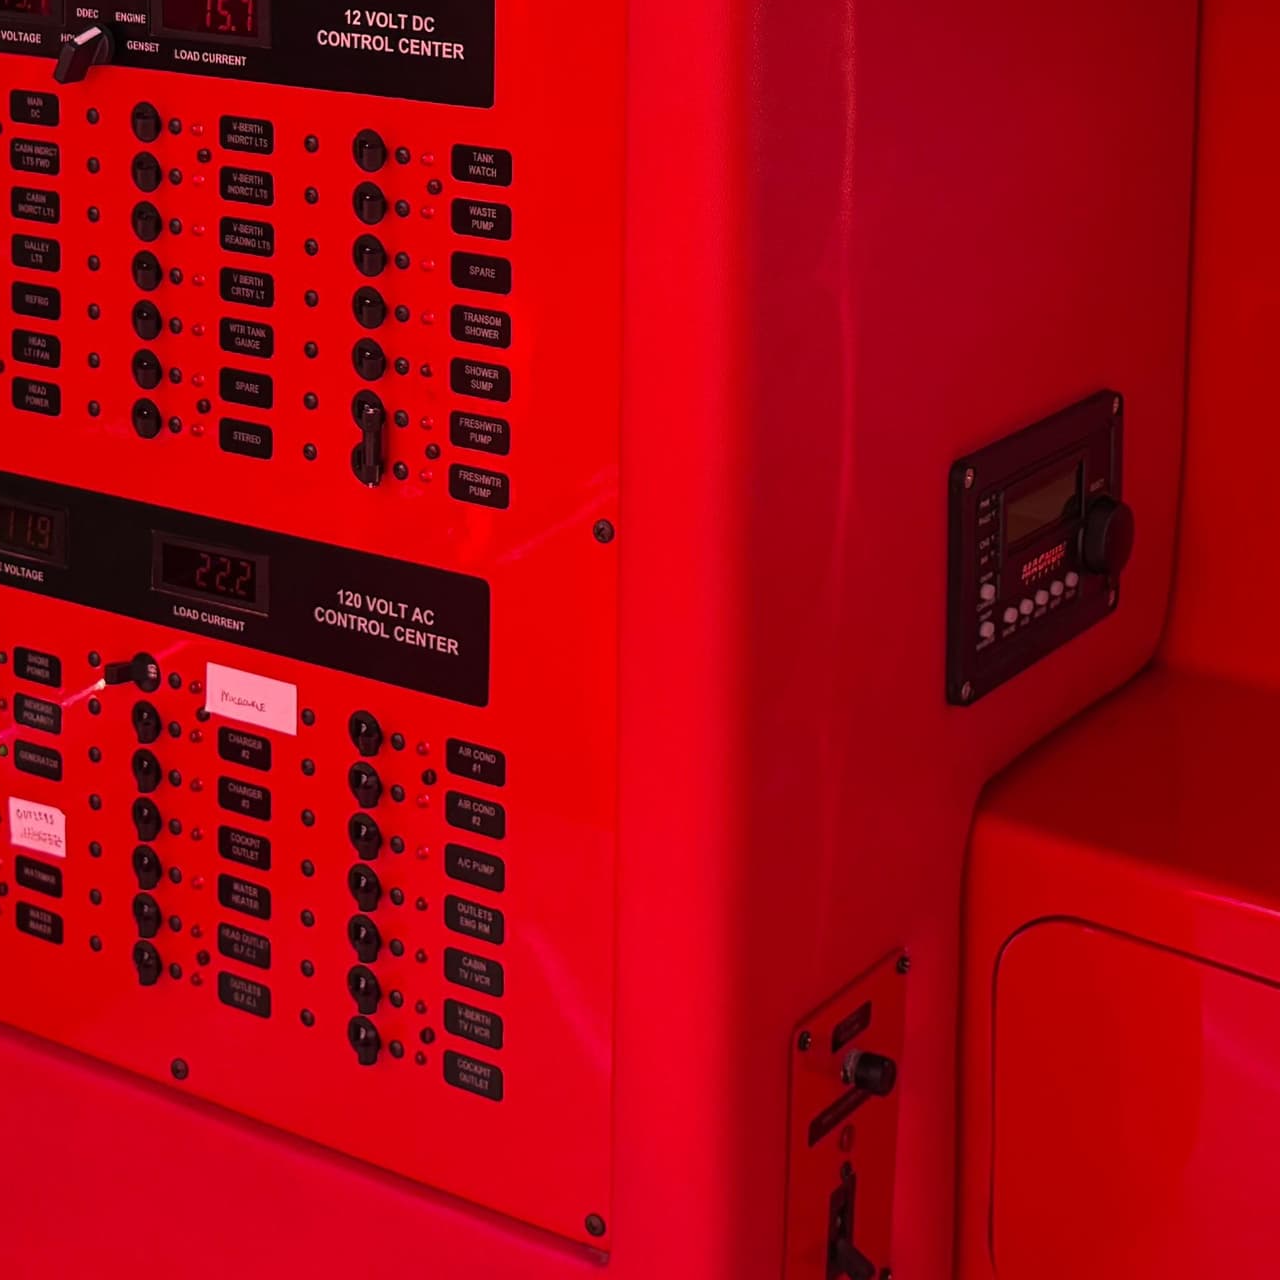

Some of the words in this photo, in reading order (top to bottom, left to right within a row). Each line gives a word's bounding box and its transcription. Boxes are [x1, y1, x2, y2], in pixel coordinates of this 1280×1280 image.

[76, 8, 99, 19] DDEC
[115, 11, 146, 24] ENGINE
[344, 9, 361, 26] 12
[365, 10, 408, 30] VOLT
[412, 15, 435, 33] DC
[1, 30, 41, 44] VOLTAGE
[317, 29, 394, 53] CONTROL
[398, 37, 465, 60] CENTER
[127, 40, 160, 53] GENSET
[174, 49, 200, 62] LOAD
[202, 52, 247, 66] CURRENT
[227, 134, 253, 145] INDRCT
[254, 137, 268, 148] LTS
[472, 152, 494, 164] TANK
[469, 165, 497, 178] WATCH
[227, 185, 253, 196] INDRCT
[255, 188, 268, 199] LTS
[469, 206, 496, 218] WASTE
[472, 219, 494, 231] PUMP
[24, 240, 49, 253] GALLEY
[225, 234, 256, 247] READING
[257, 240, 270, 250] LTS
[469, 265, 496, 278] SPARE
[255, 290, 264, 300] LT
[464, 312, 501, 327] TRANSOM
[247, 326, 266, 338] TANK
[464, 325, 499, 340] SHOWER
[235, 337, 260, 350] GAUGE
[465, 365, 499, 380] SHOWER
[235, 381, 259, 393] SPARE
[470, 379, 493, 391] SUMP
[459, 417, 502, 433] FRESHWTR
[233, 431, 261, 444] STEREO
[470, 432, 492, 444] PUMP
[459, 470, 501, 488] FRESHWTR
[469, 485, 491, 497] PUMP
[4, 563, 44, 581] VOLTAGE
[196, 553, 251, 595] 22.2
[337, 589, 361, 608] 120
[366, 595, 408, 619] VOLT
[412, 607, 434, 626] AC
[173, 605, 199, 620] LOAD
[201, 612, 245, 631] CURRENT
[314, 606, 390, 639] CONTROL
[394, 626, 459, 656] CENTER
[228, 733, 262, 750] CHARGER
[458, 746, 472, 758] AIR
[473, 750, 496, 764] COND
[472, 763, 481, 774] #1
[228, 782, 262, 800] CHARGER
[458, 798, 471, 810] AIR
[472, 802, 495, 816] COND
[472, 815, 481, 826] #2
[231, 832, 260, 848] COCKPIT
[232, 845, 259, 861] OUTLET
[457, 857, 471, 868] A/C
[472, 861, 495, 874] PUMP
[233, 881, 258, 898] WATER
[457, 902, 493, 922] OUTLETS
[460, 916, 476, 930] ENG
[478, 921, 490, 934] RM
[462, 957, 487, 972] CABIN
[457, 1058, 491, 1078] COCKPIT
[459, 1071, 489, 1090] OUTLET
